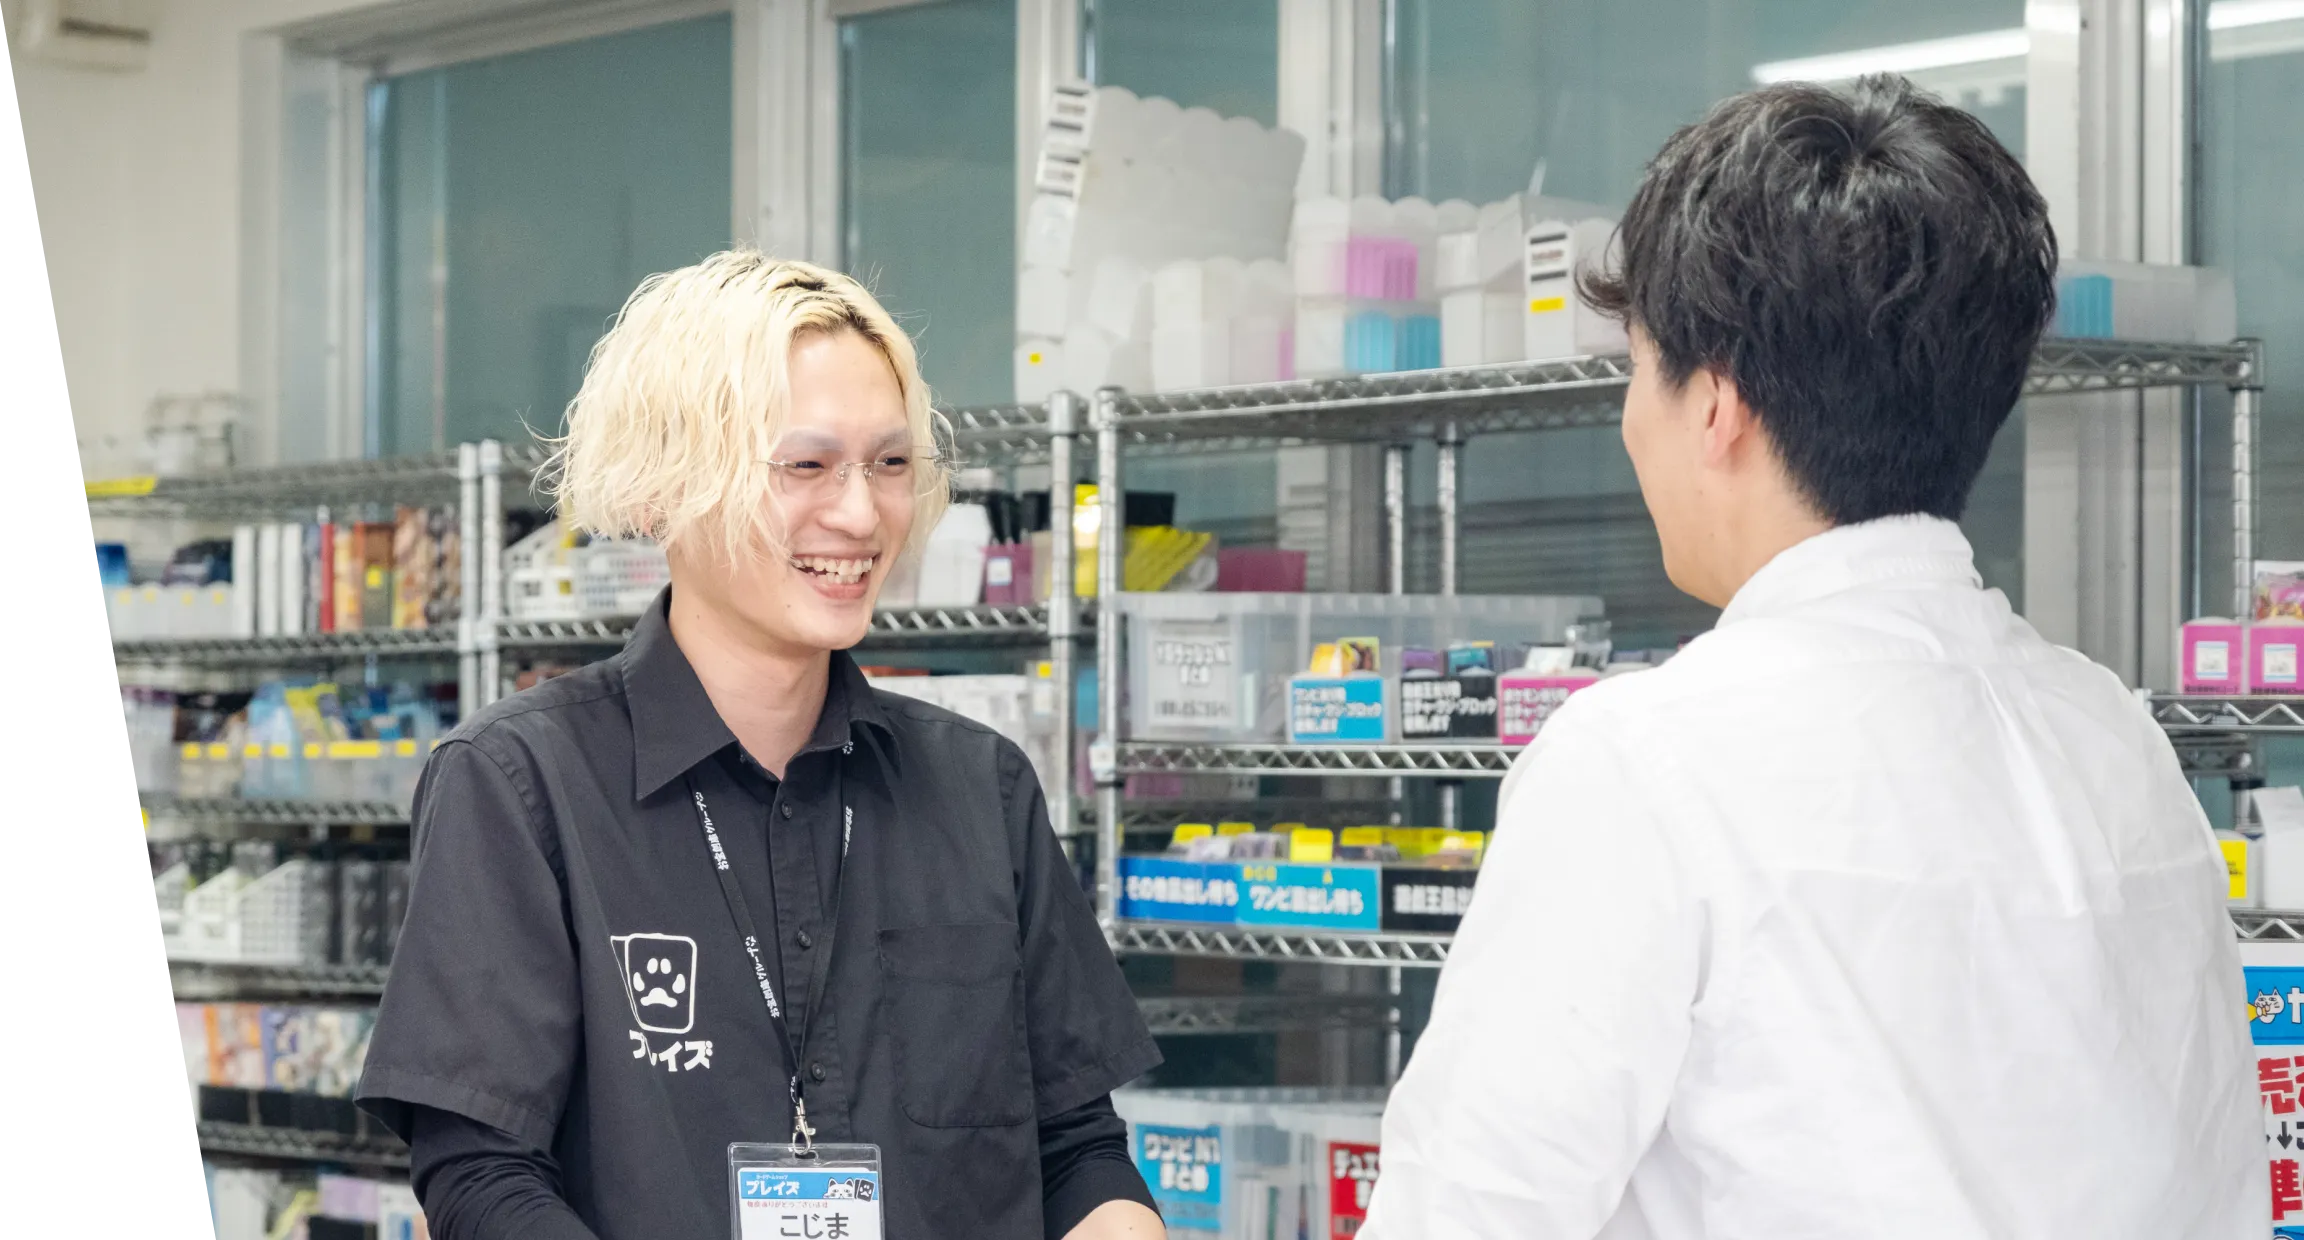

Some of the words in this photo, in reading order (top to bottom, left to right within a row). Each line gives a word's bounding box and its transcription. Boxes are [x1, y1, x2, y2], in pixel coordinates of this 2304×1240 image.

[746, 1180, 801, 1196] プレイズ
[780, 1212, 850, 1240] こじま
